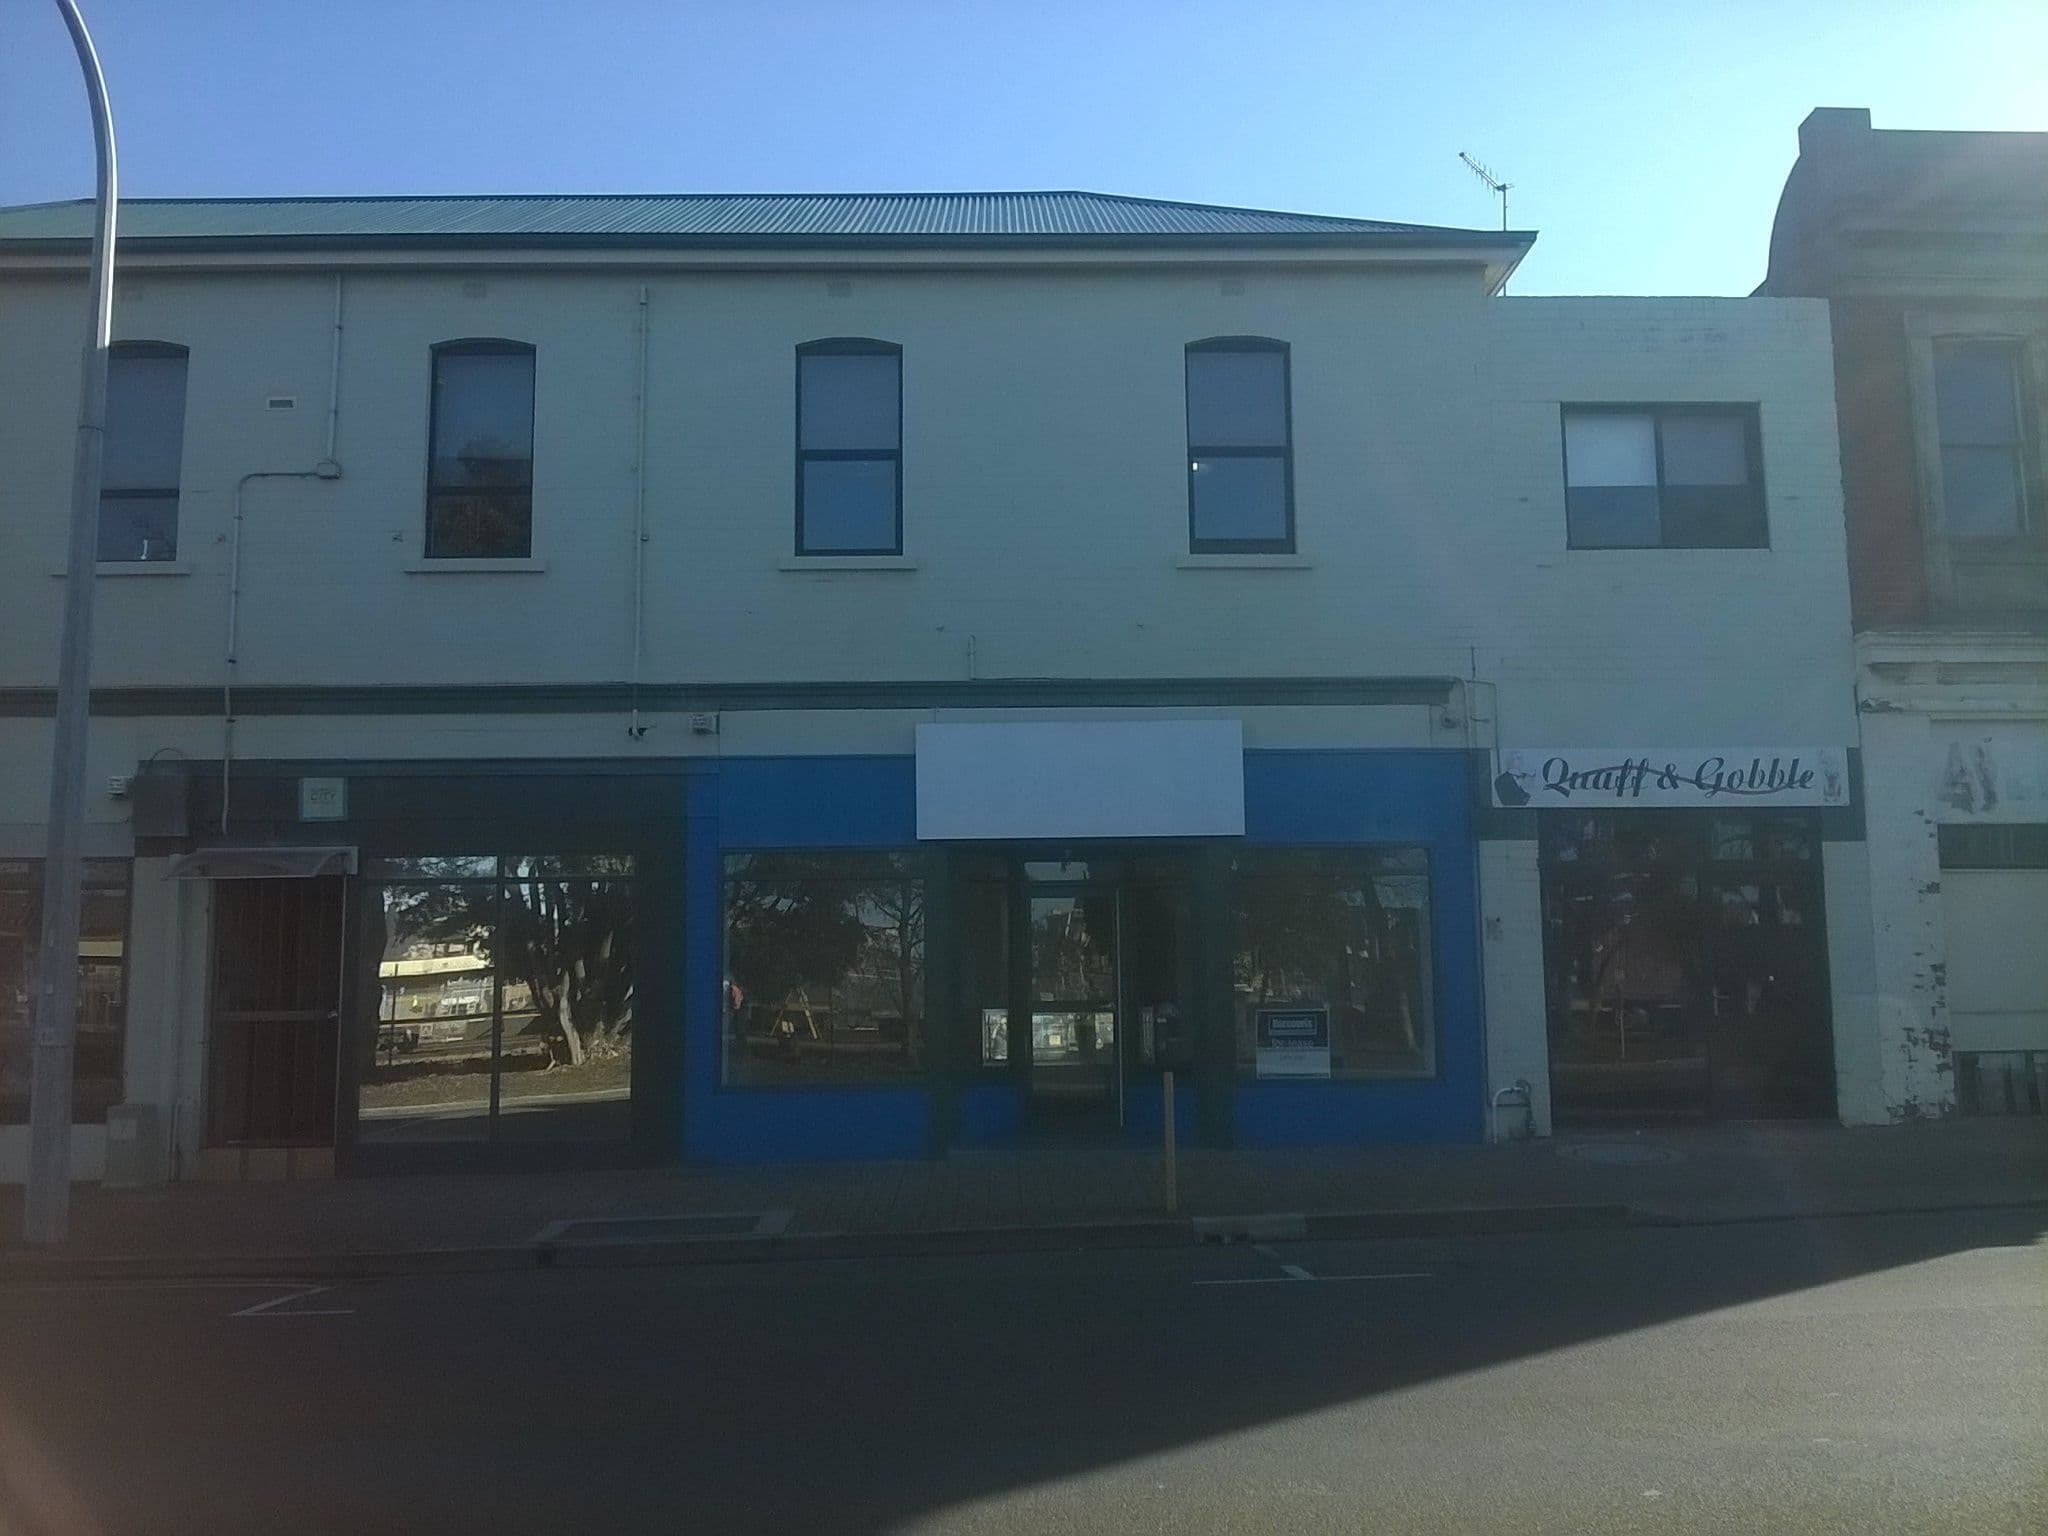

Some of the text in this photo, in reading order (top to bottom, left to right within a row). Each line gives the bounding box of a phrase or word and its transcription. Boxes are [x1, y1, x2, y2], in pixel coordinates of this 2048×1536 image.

[1541, 757, 1816, 799] Quaff & Gobble
